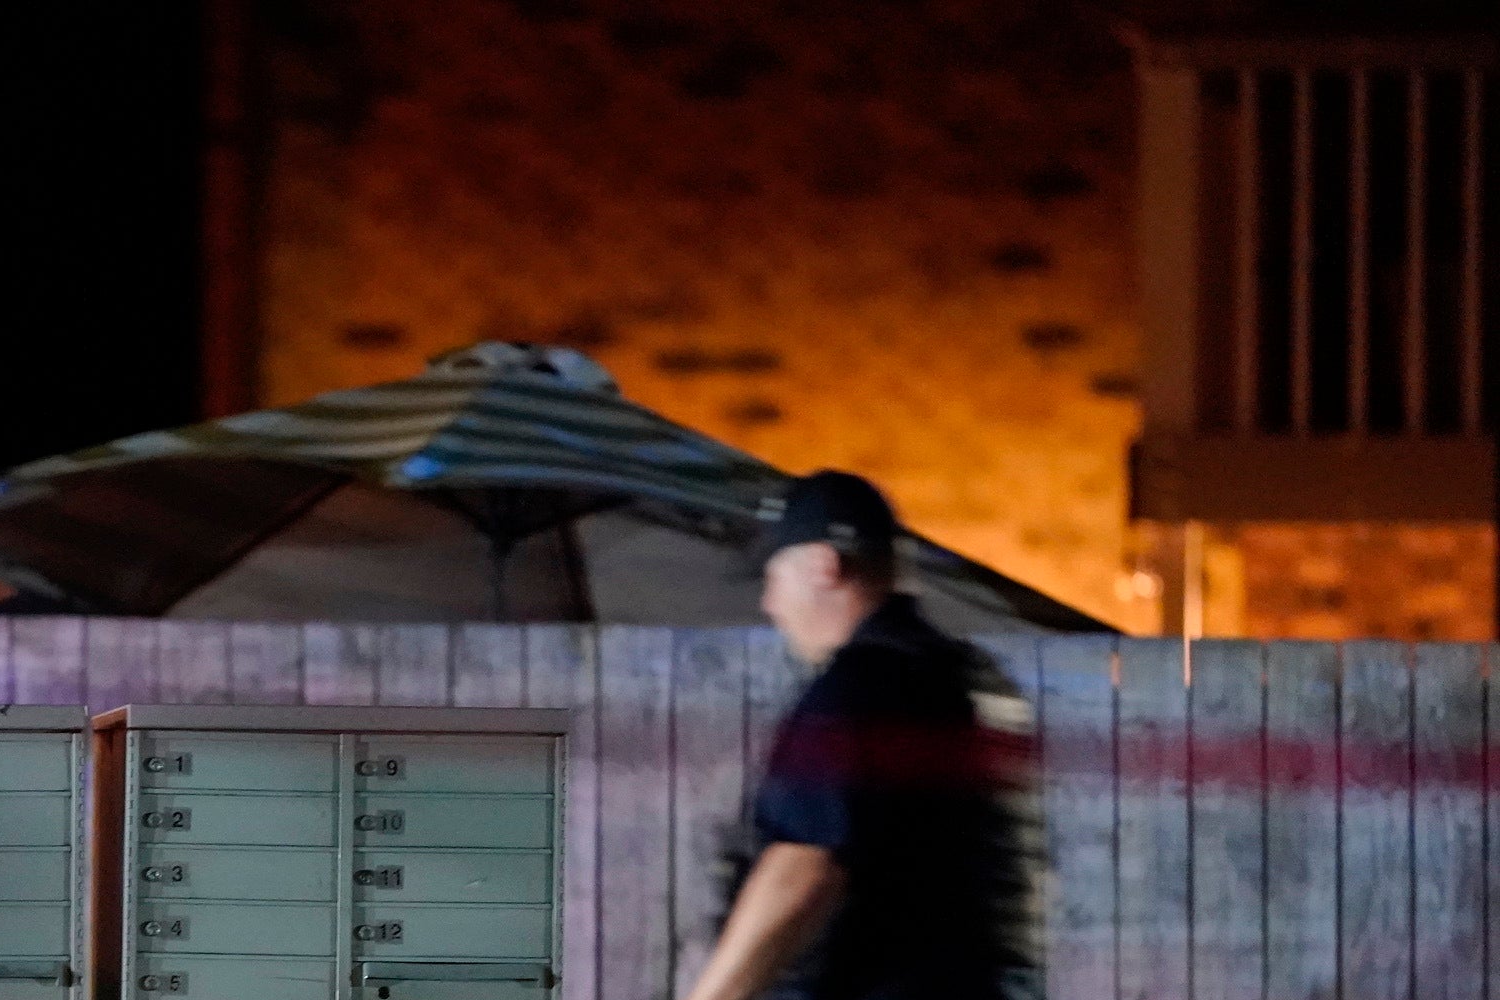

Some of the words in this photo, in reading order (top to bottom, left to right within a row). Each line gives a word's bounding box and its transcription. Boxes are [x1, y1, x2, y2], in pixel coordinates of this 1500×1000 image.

[176, 756, 183, 773] 1
[386, 759, 398, 776] 9
[172, 812, 184, 828] 2
[171, 866, 183, 883] 3
[381, 869, 402, 886] 11
[171, 920, 182, 937] 4
[379, 923, 402, 940] 12
[170, 975, 181, 992] 5
